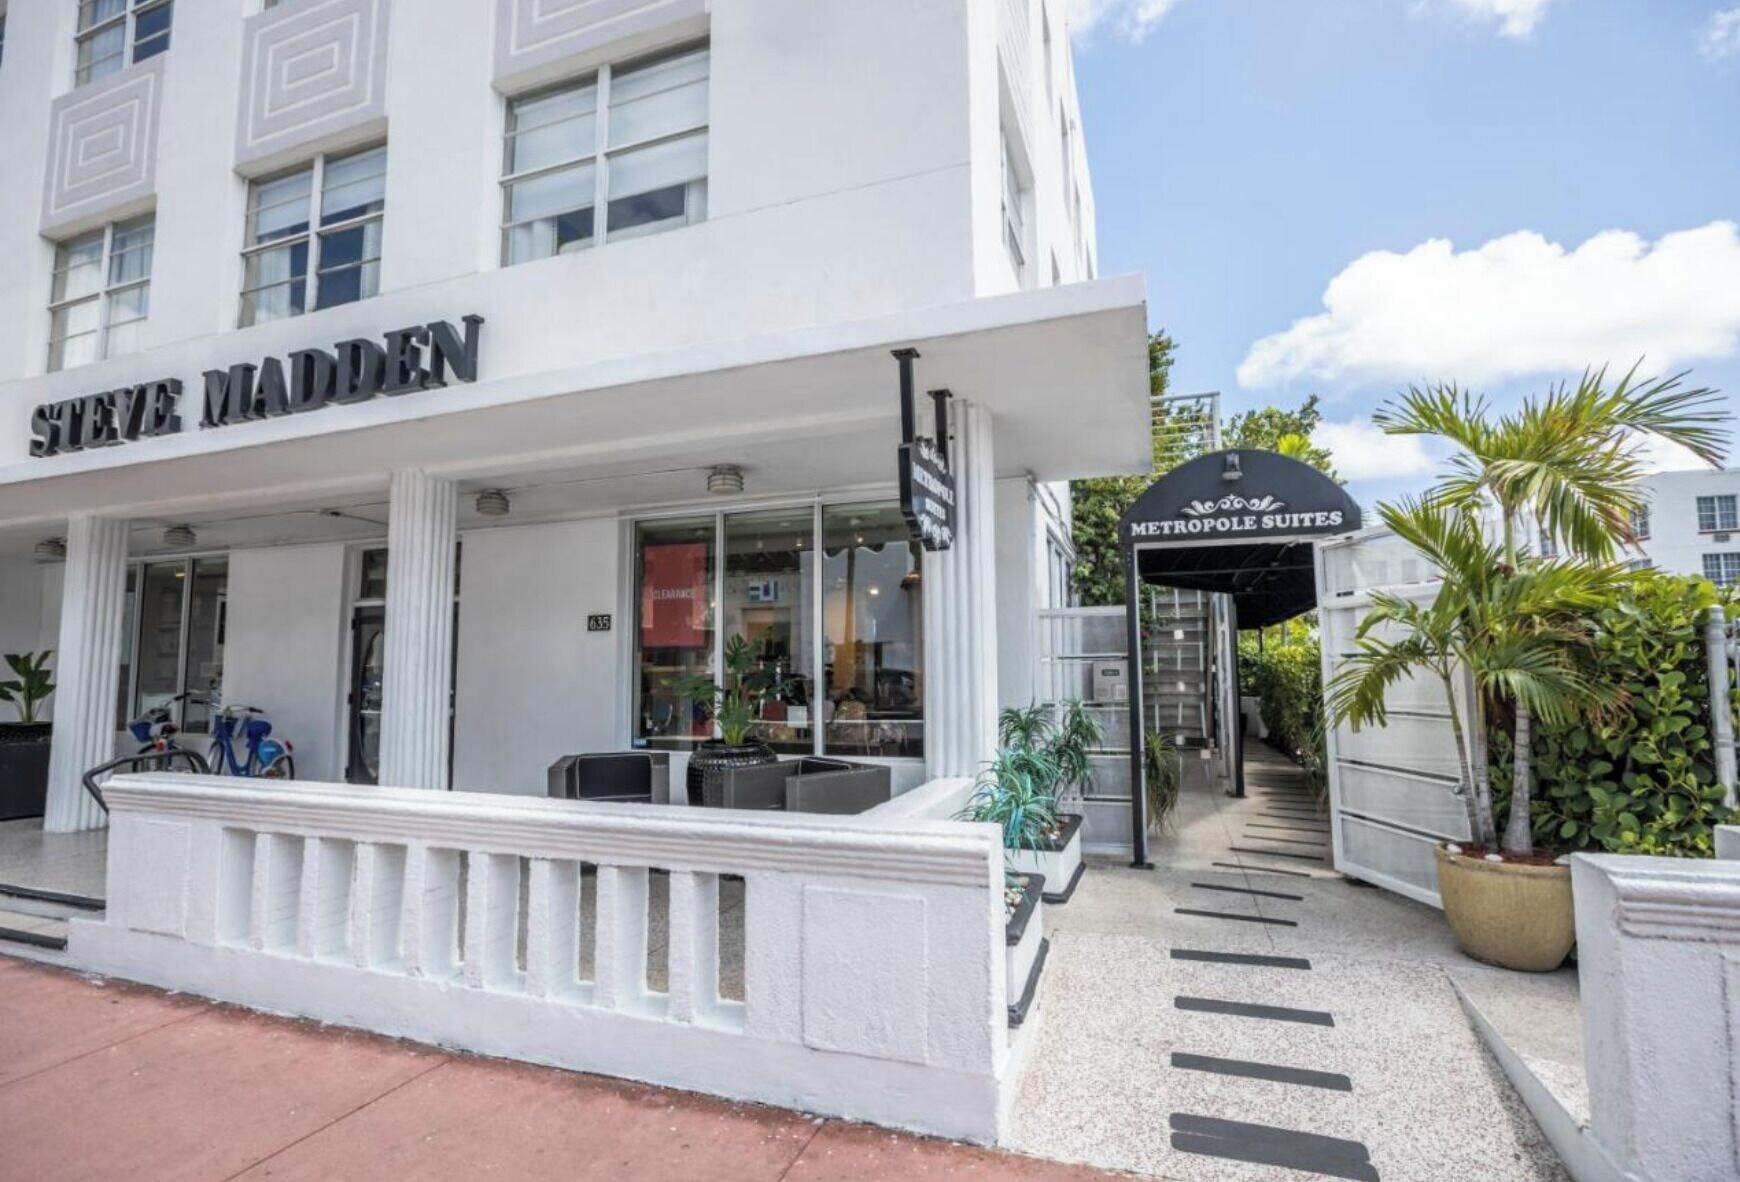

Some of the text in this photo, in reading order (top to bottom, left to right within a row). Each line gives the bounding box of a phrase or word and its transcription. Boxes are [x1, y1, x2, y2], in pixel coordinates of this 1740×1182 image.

[29, 313, 486, 458] STEVE MADDEN
[1130, 510, 1343, 537] METROPOLE SUITES
[652, 587, 696, 600] CLEARANCE
[589, 615, 610, 630] 635
